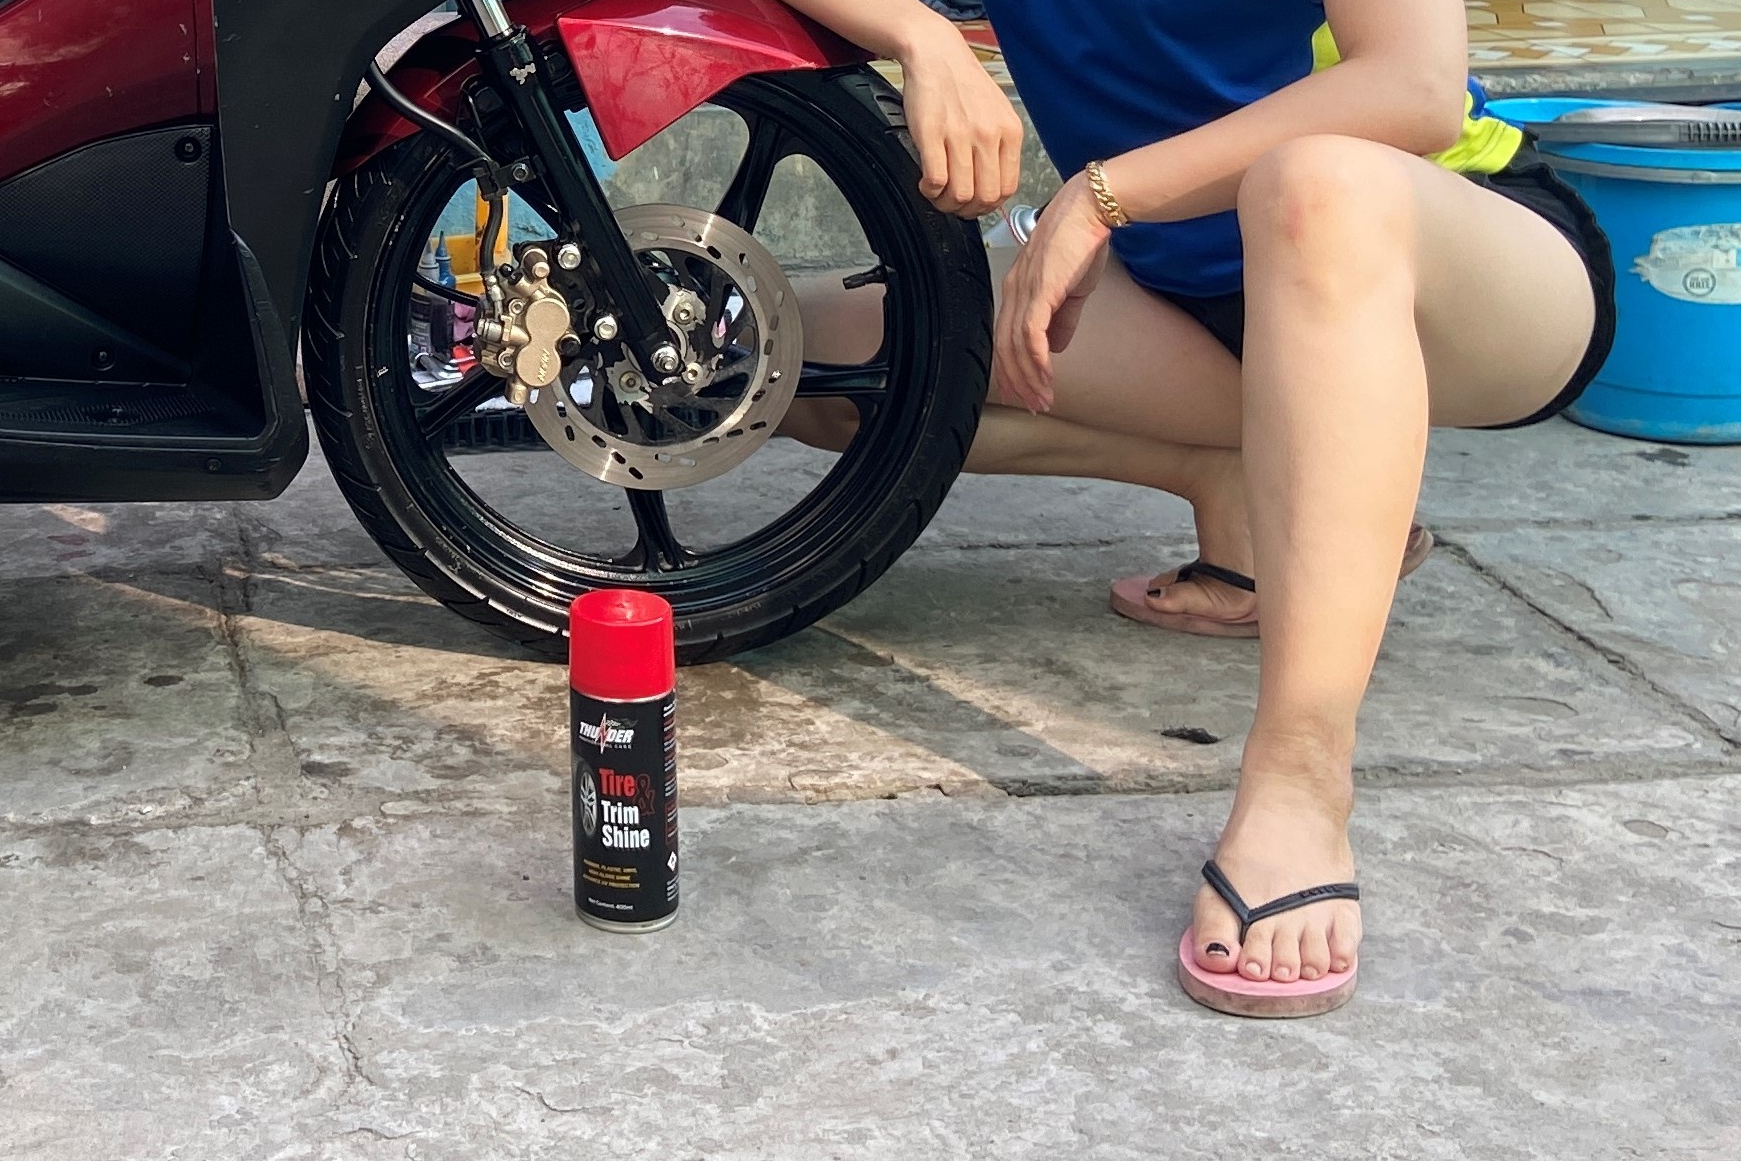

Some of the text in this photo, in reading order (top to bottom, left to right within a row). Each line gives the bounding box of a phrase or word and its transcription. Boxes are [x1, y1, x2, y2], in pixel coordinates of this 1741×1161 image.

[599, 768, 636, 797] Tire
[601, 800, 640, 825] Trim
[602, 824, 650, 849] Shine
